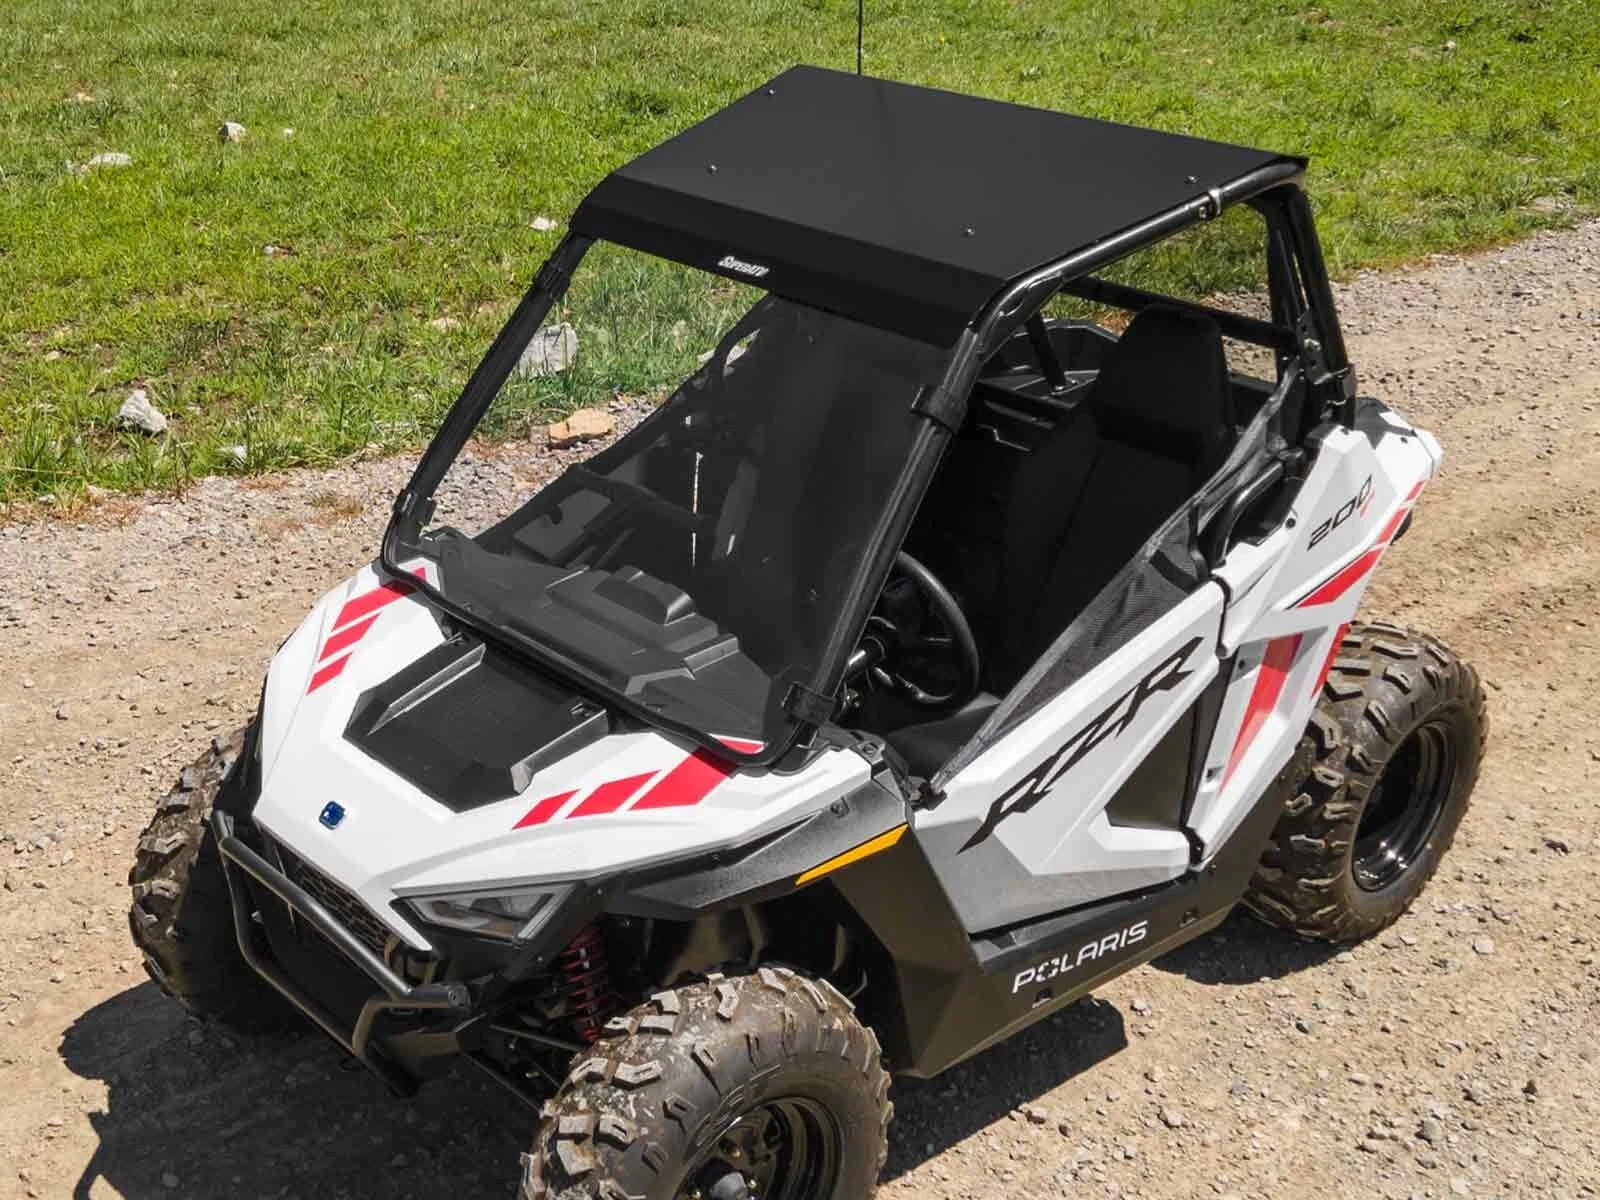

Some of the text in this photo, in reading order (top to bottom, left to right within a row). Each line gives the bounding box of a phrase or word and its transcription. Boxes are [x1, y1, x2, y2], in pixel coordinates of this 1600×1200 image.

[1307, 474, 1373, 551] 200
[955, 636, 1204, 855] RZR
[1011, 920, 1148, 993] POLARIS
